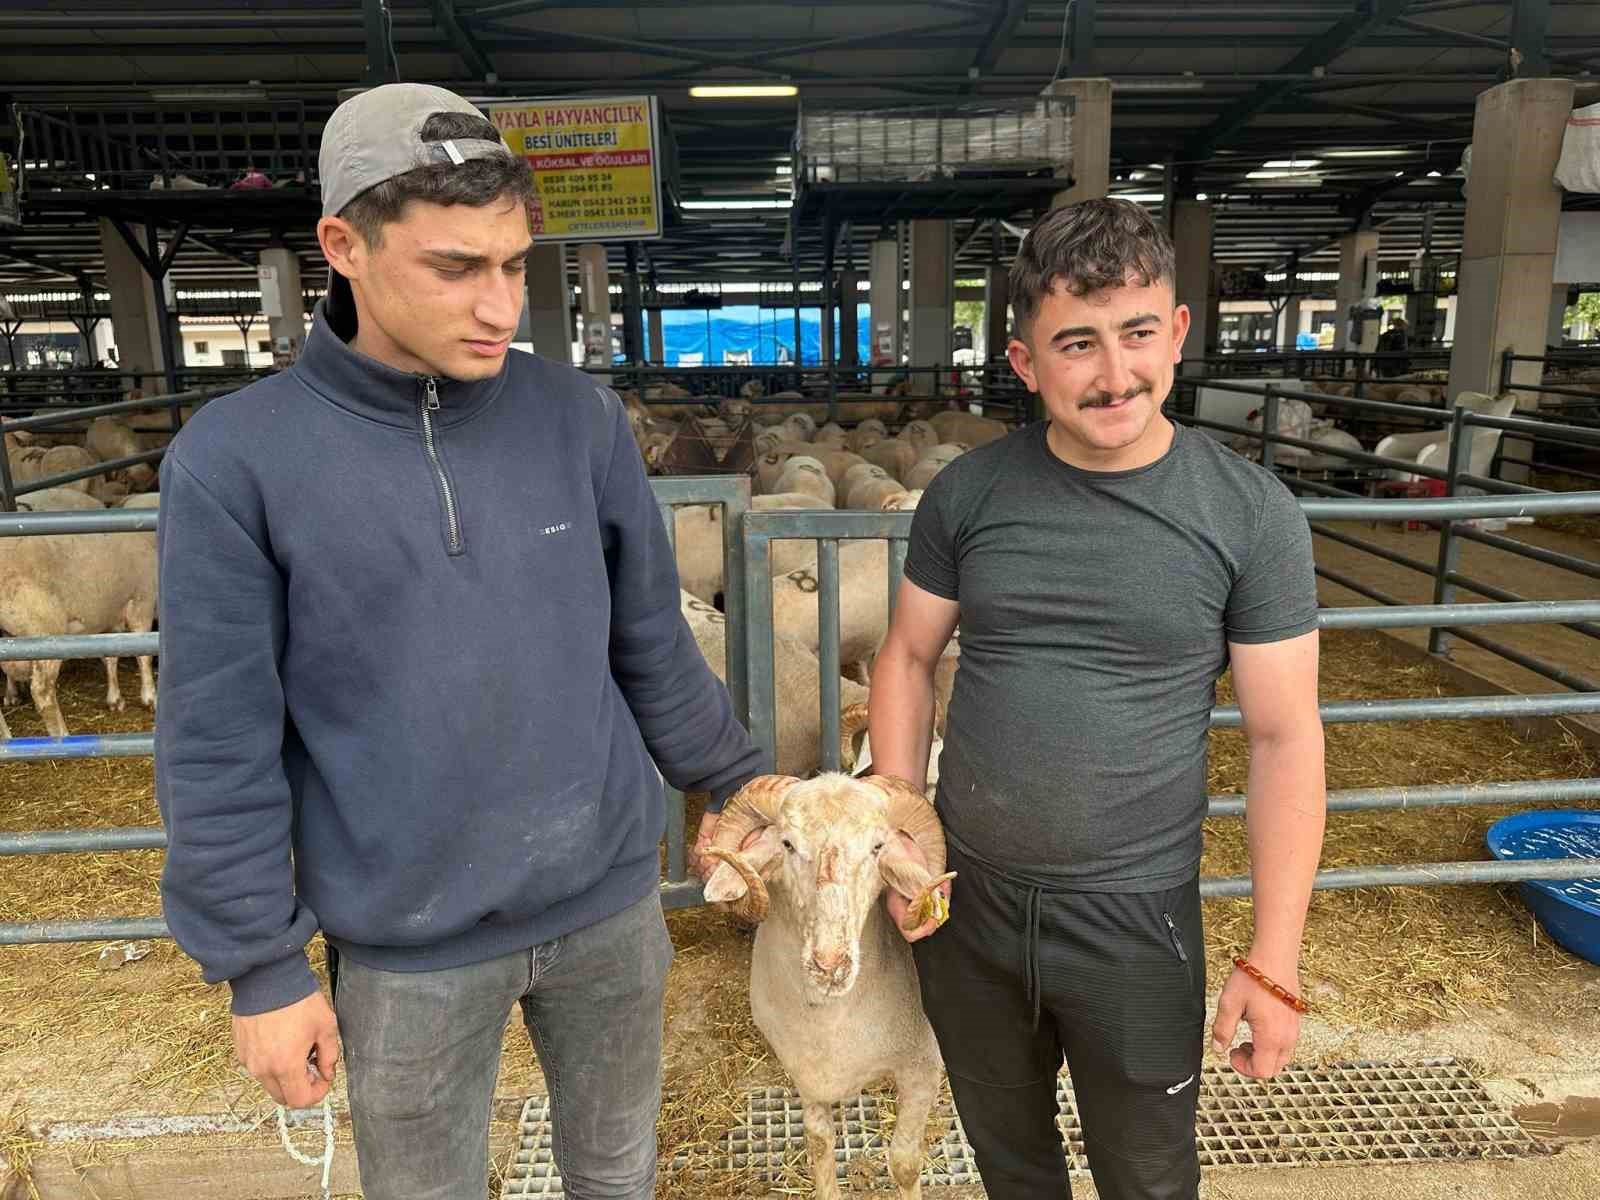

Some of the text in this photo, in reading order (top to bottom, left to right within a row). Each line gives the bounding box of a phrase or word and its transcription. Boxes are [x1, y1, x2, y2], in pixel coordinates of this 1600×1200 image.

[495, 106, 643, 129] YAYLA HAYVANCILIK
[579, 157, 593, 167] VE
